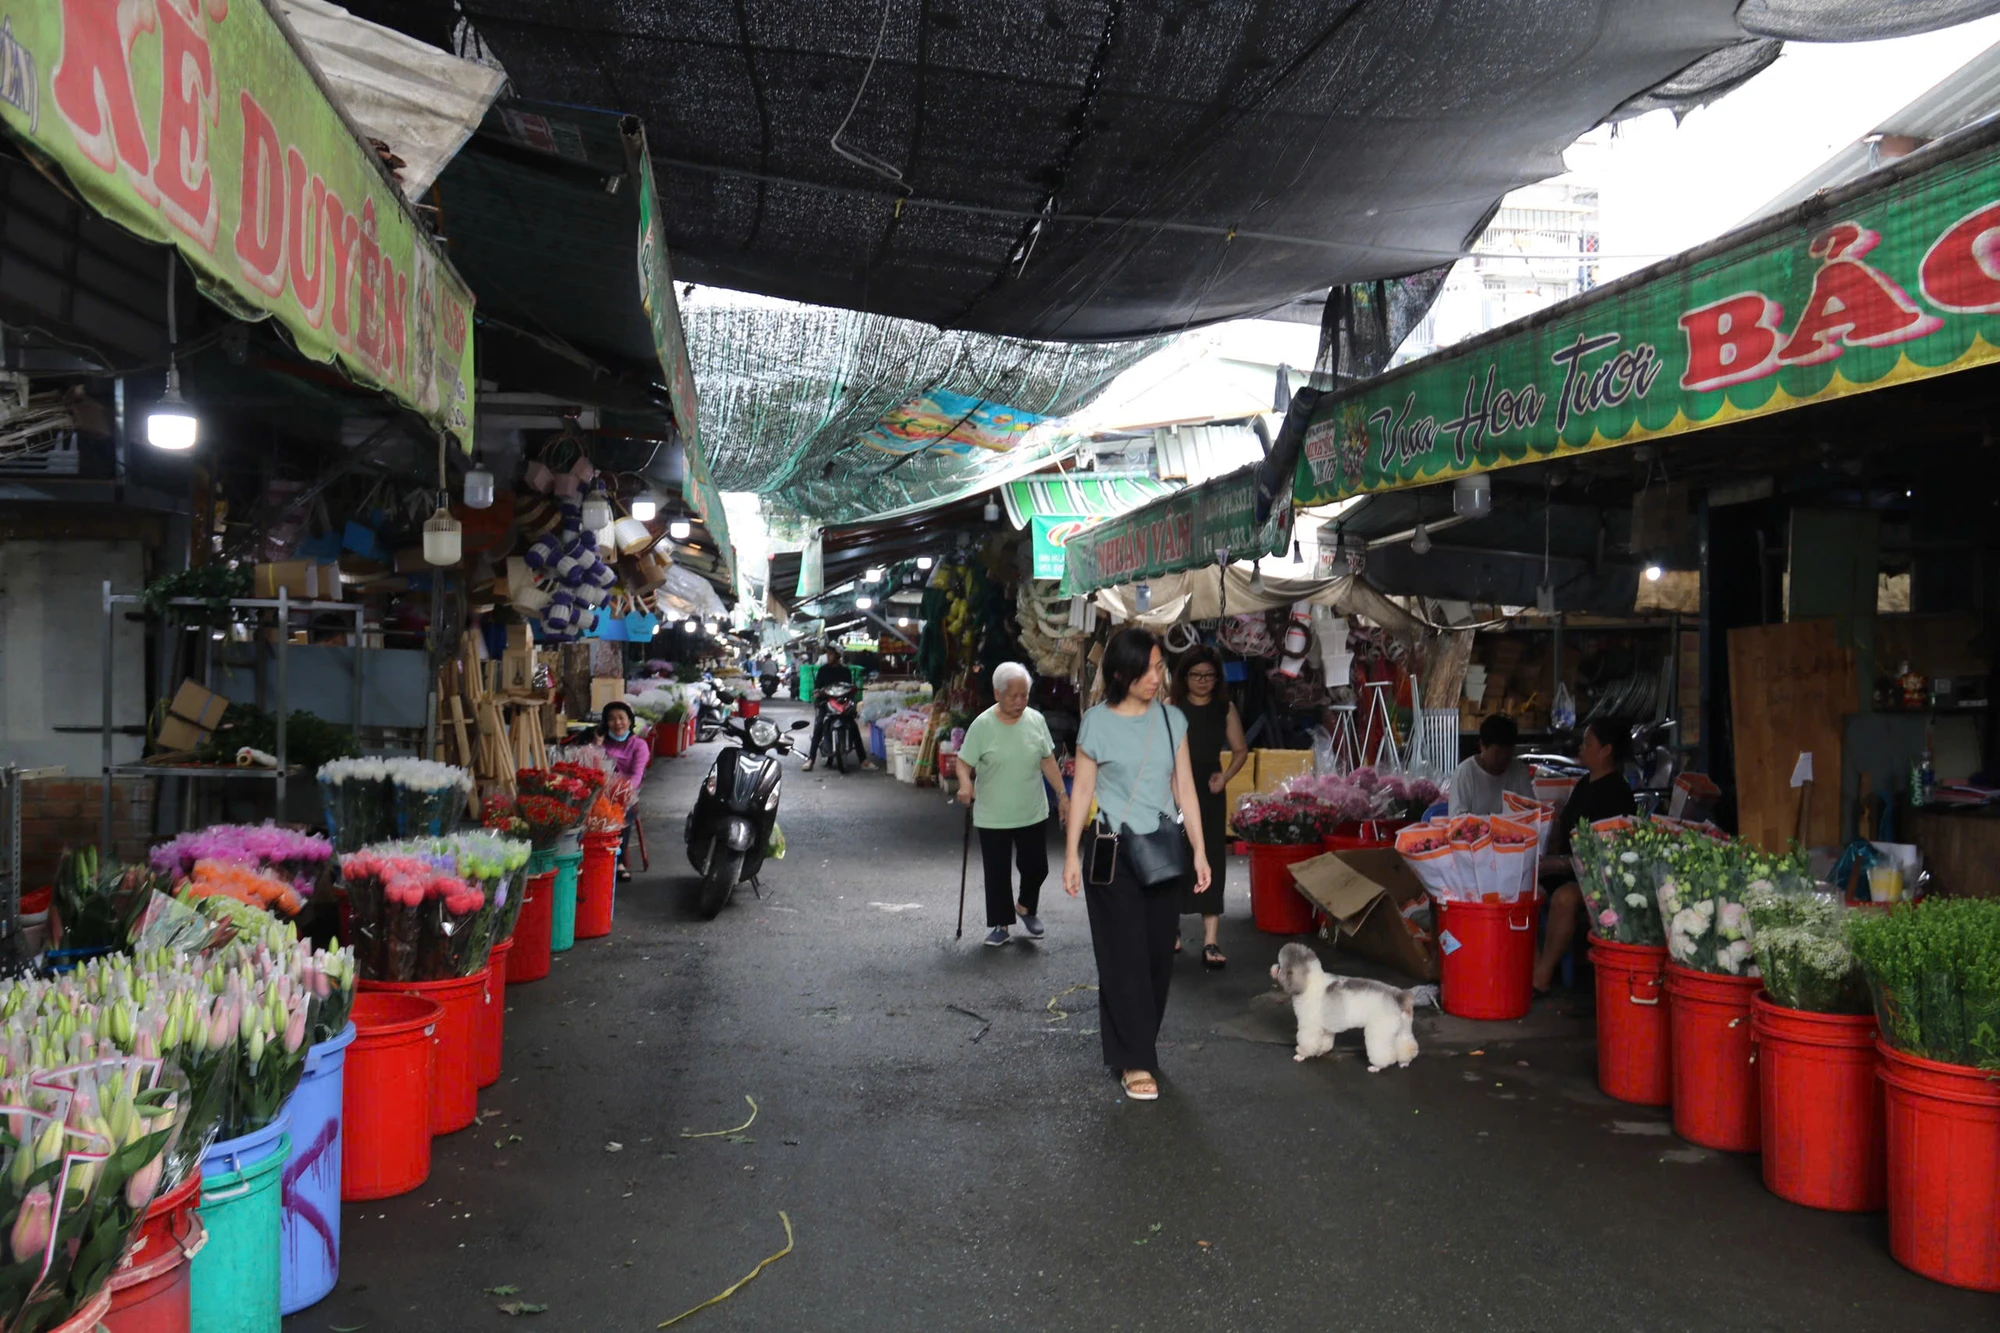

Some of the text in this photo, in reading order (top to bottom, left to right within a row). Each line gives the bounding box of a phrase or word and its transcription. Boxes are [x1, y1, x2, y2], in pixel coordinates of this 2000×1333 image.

[235, 88, 409, 392] DUYÊN
[1369, 391, 1440, 471] Vựa
[1442, 364, 1545, 464] Hoa
[1552, 333, 1662, 433] Tươi
[1150, 504, 1193, 566] VÂN
